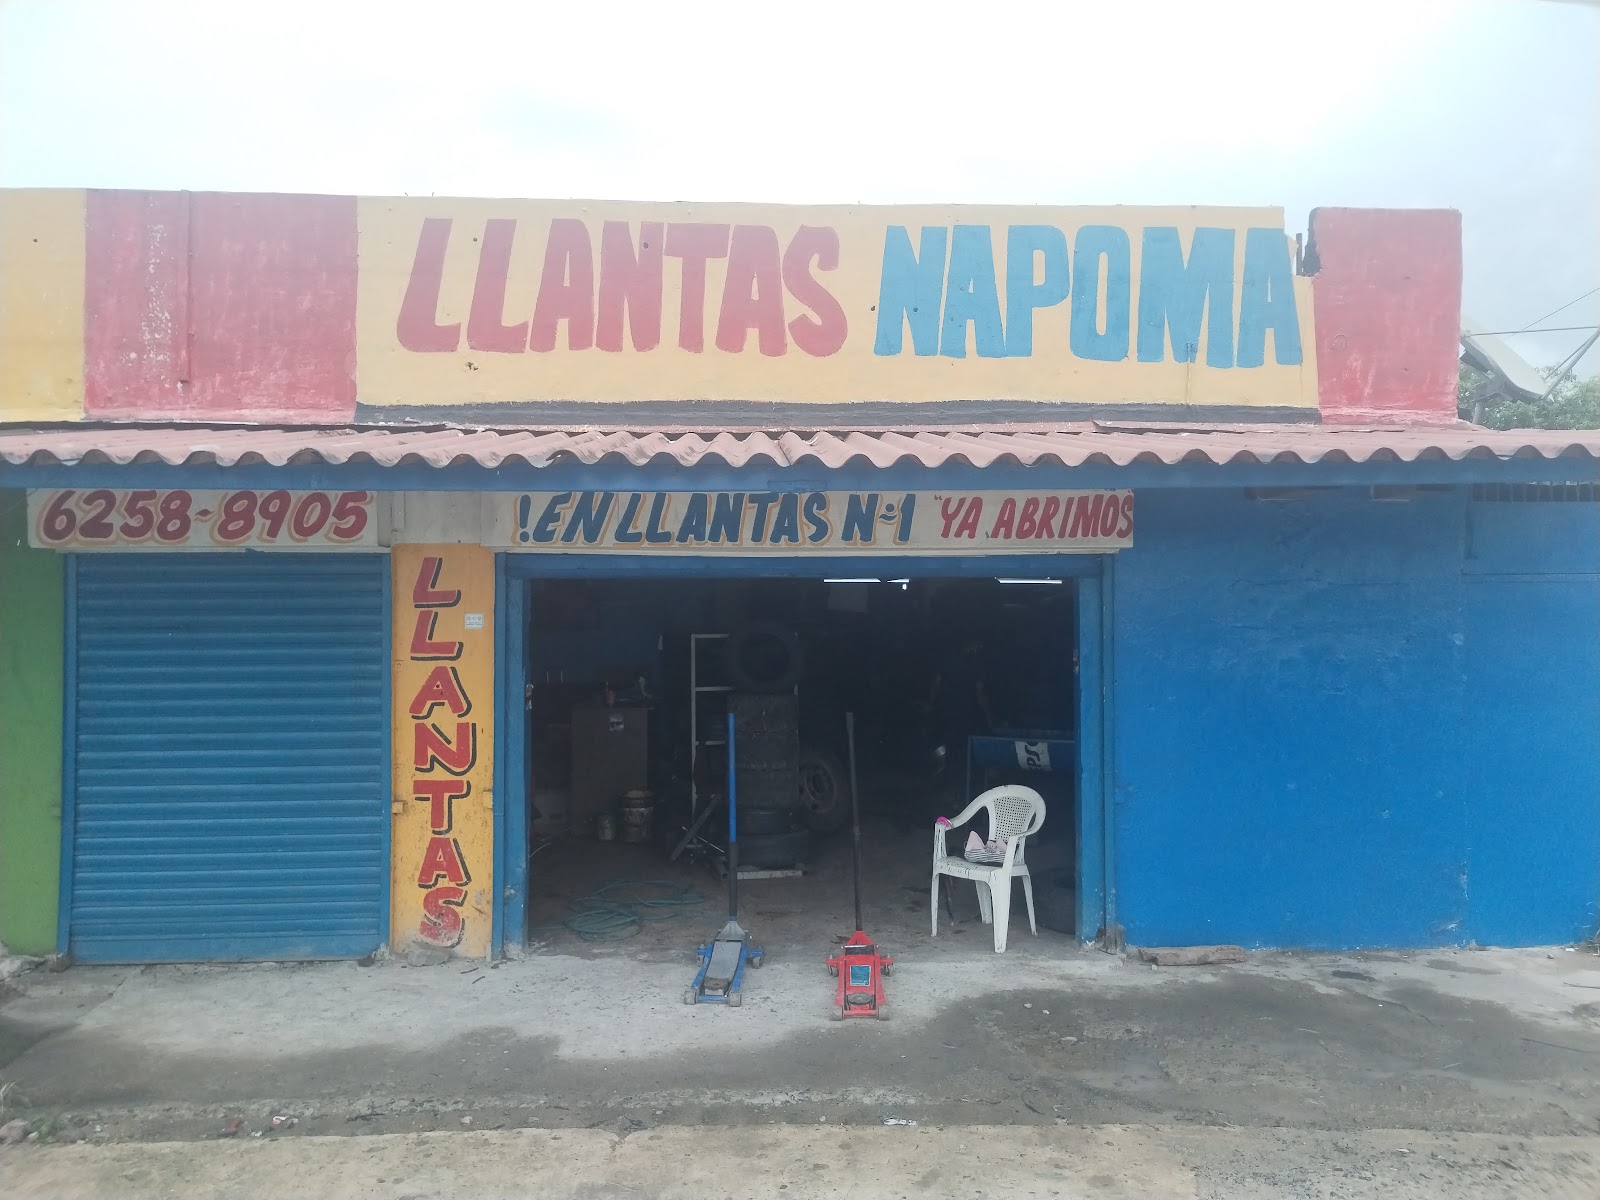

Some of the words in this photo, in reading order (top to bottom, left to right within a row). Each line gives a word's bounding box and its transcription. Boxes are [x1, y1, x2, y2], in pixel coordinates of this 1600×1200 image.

[397, 217, 848, 357] LLANTAS
[874, 224, 1303, 368] NAPOMA
[40, 490, 370, 544] 6258-8905
[614, 491, 829, 544] LLANTAS
[409, 556, 475, 947] LLANTAS
